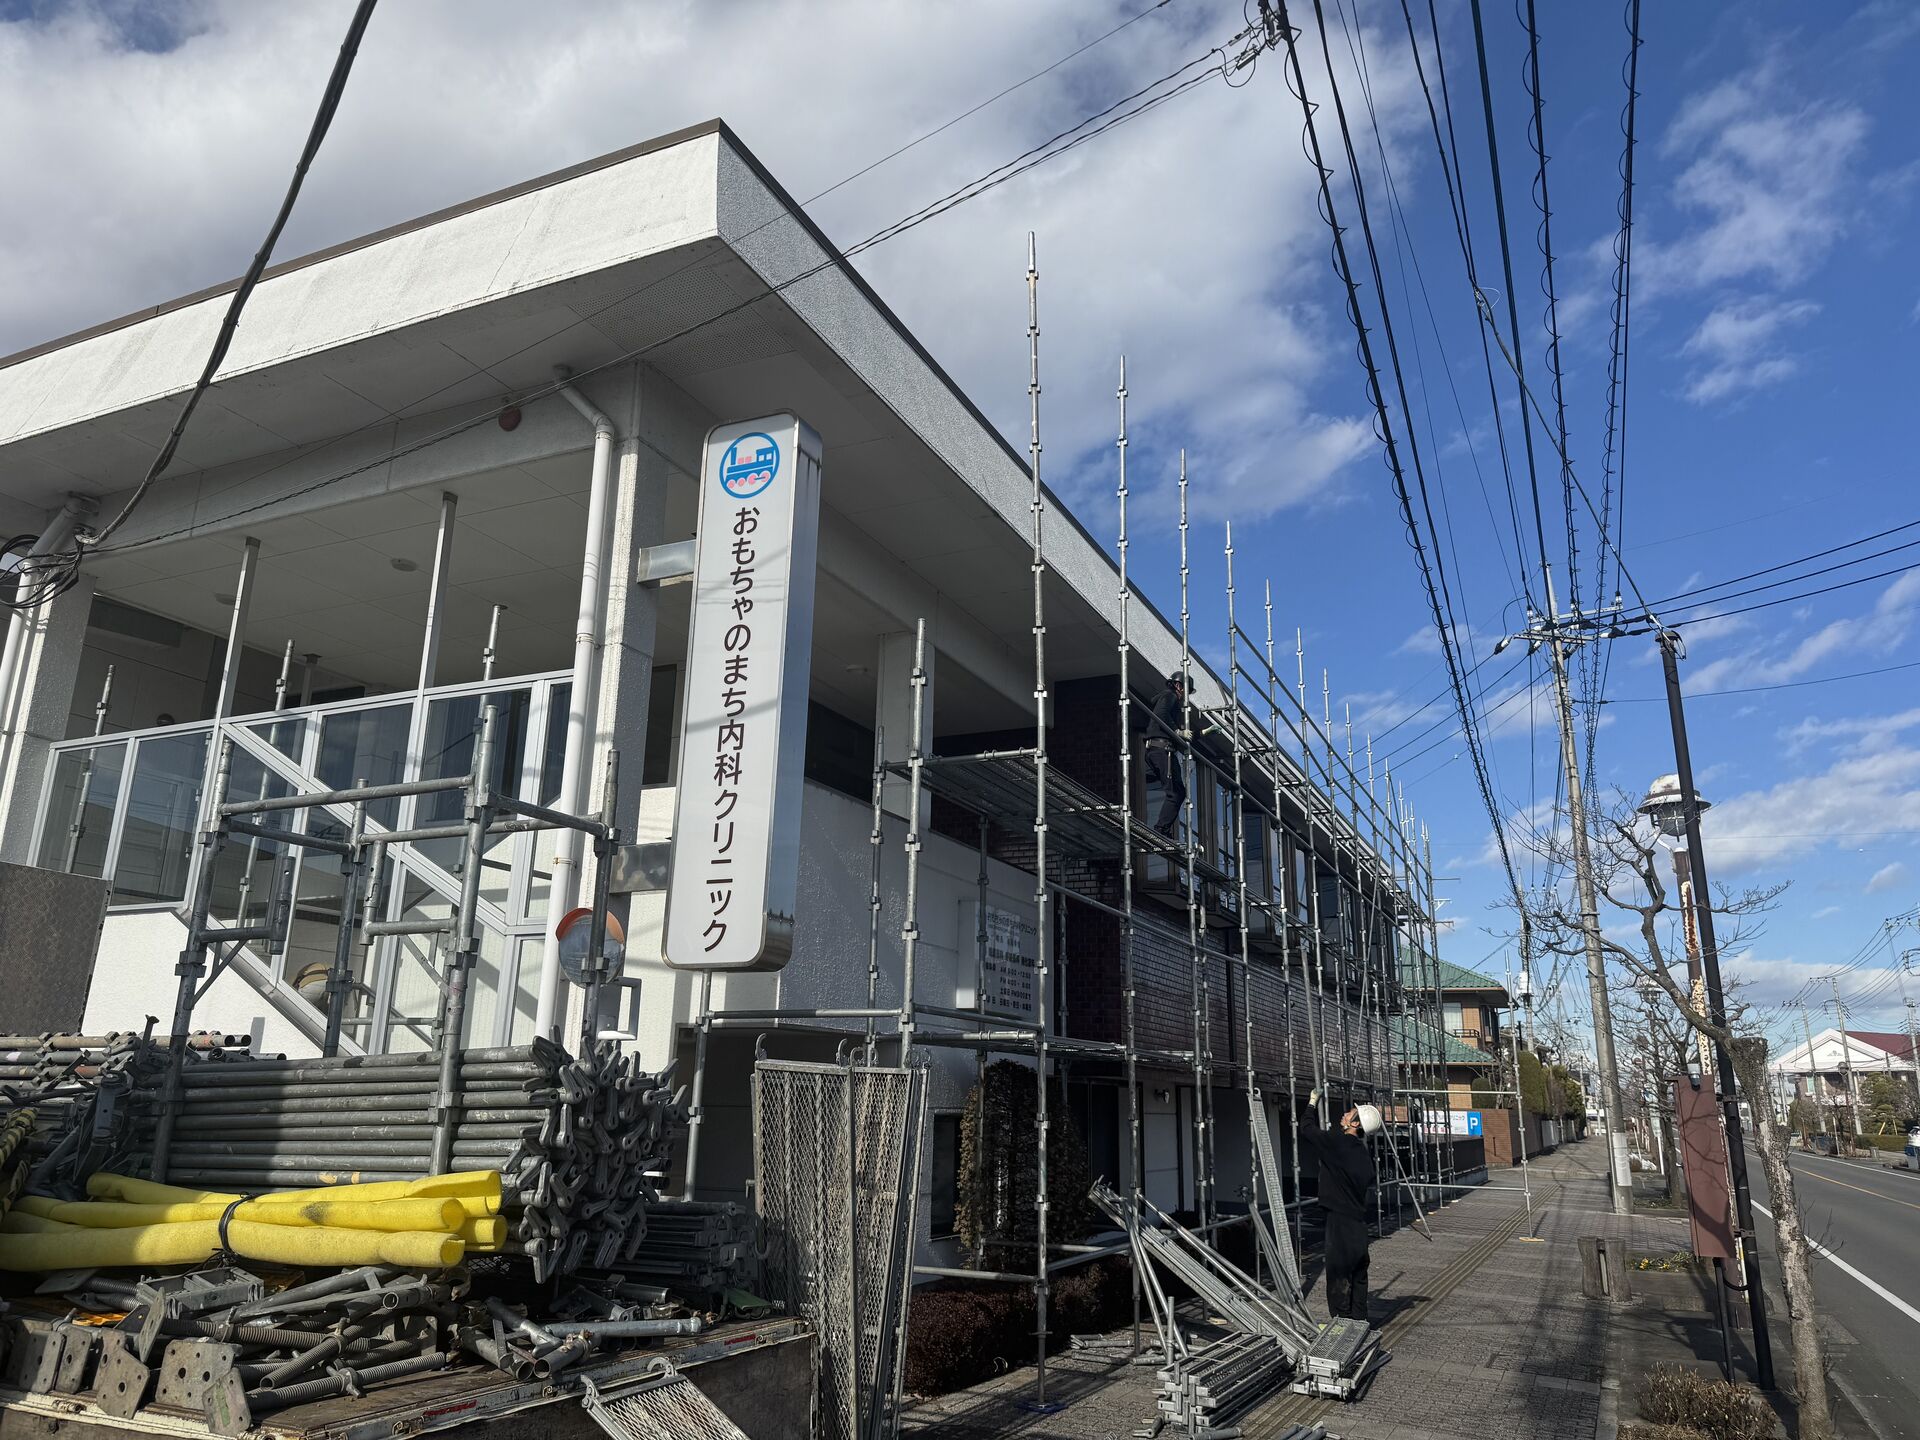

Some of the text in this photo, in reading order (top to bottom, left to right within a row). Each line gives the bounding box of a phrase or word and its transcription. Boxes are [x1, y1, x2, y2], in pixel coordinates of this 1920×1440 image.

[702, 506, 760, 952] おもちゃのまち内科クリニック
[1470, 1117, 1478, 1129] P
